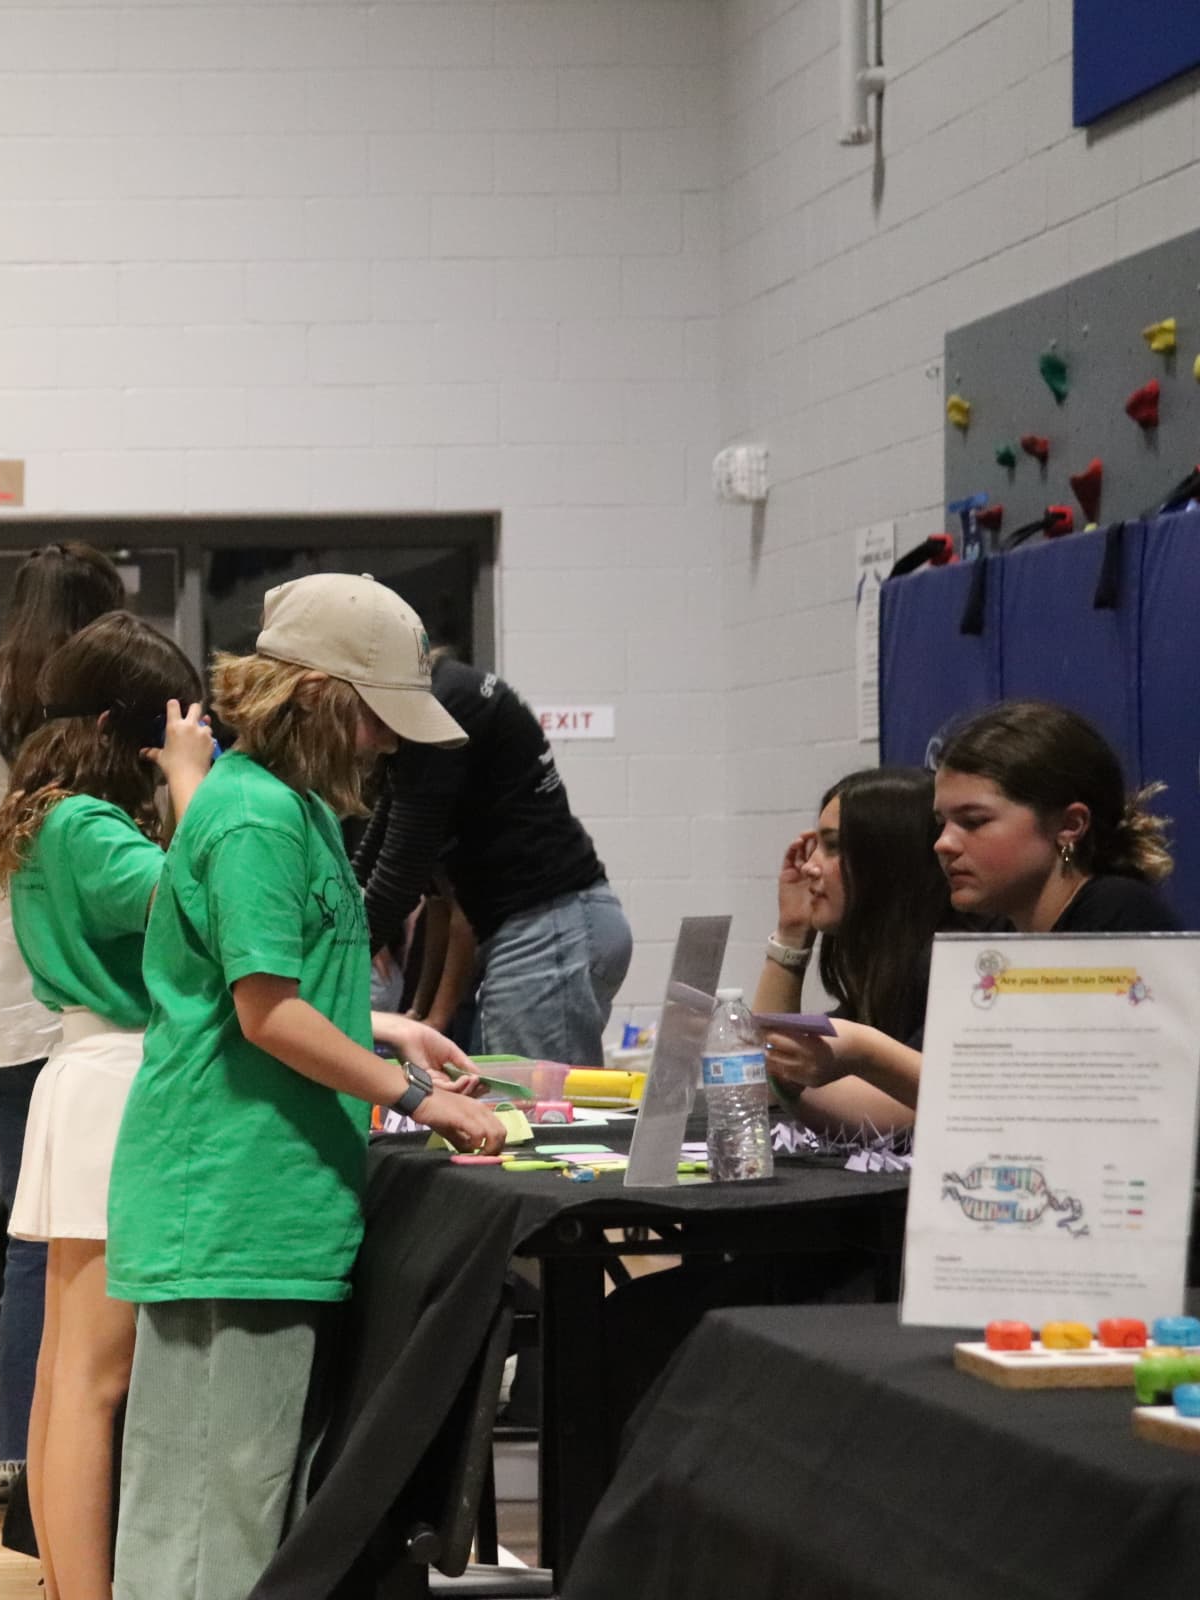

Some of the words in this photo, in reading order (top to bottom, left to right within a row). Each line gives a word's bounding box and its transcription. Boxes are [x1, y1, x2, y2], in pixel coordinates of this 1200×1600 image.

[540, 711, 593, 730] EXIT
[1000, 975, 1017, 985] Are
[1019, 977, 1039, 988] you
[1040, 974, 1069, 985] faster
[1071, 974, 1096, 985] than
